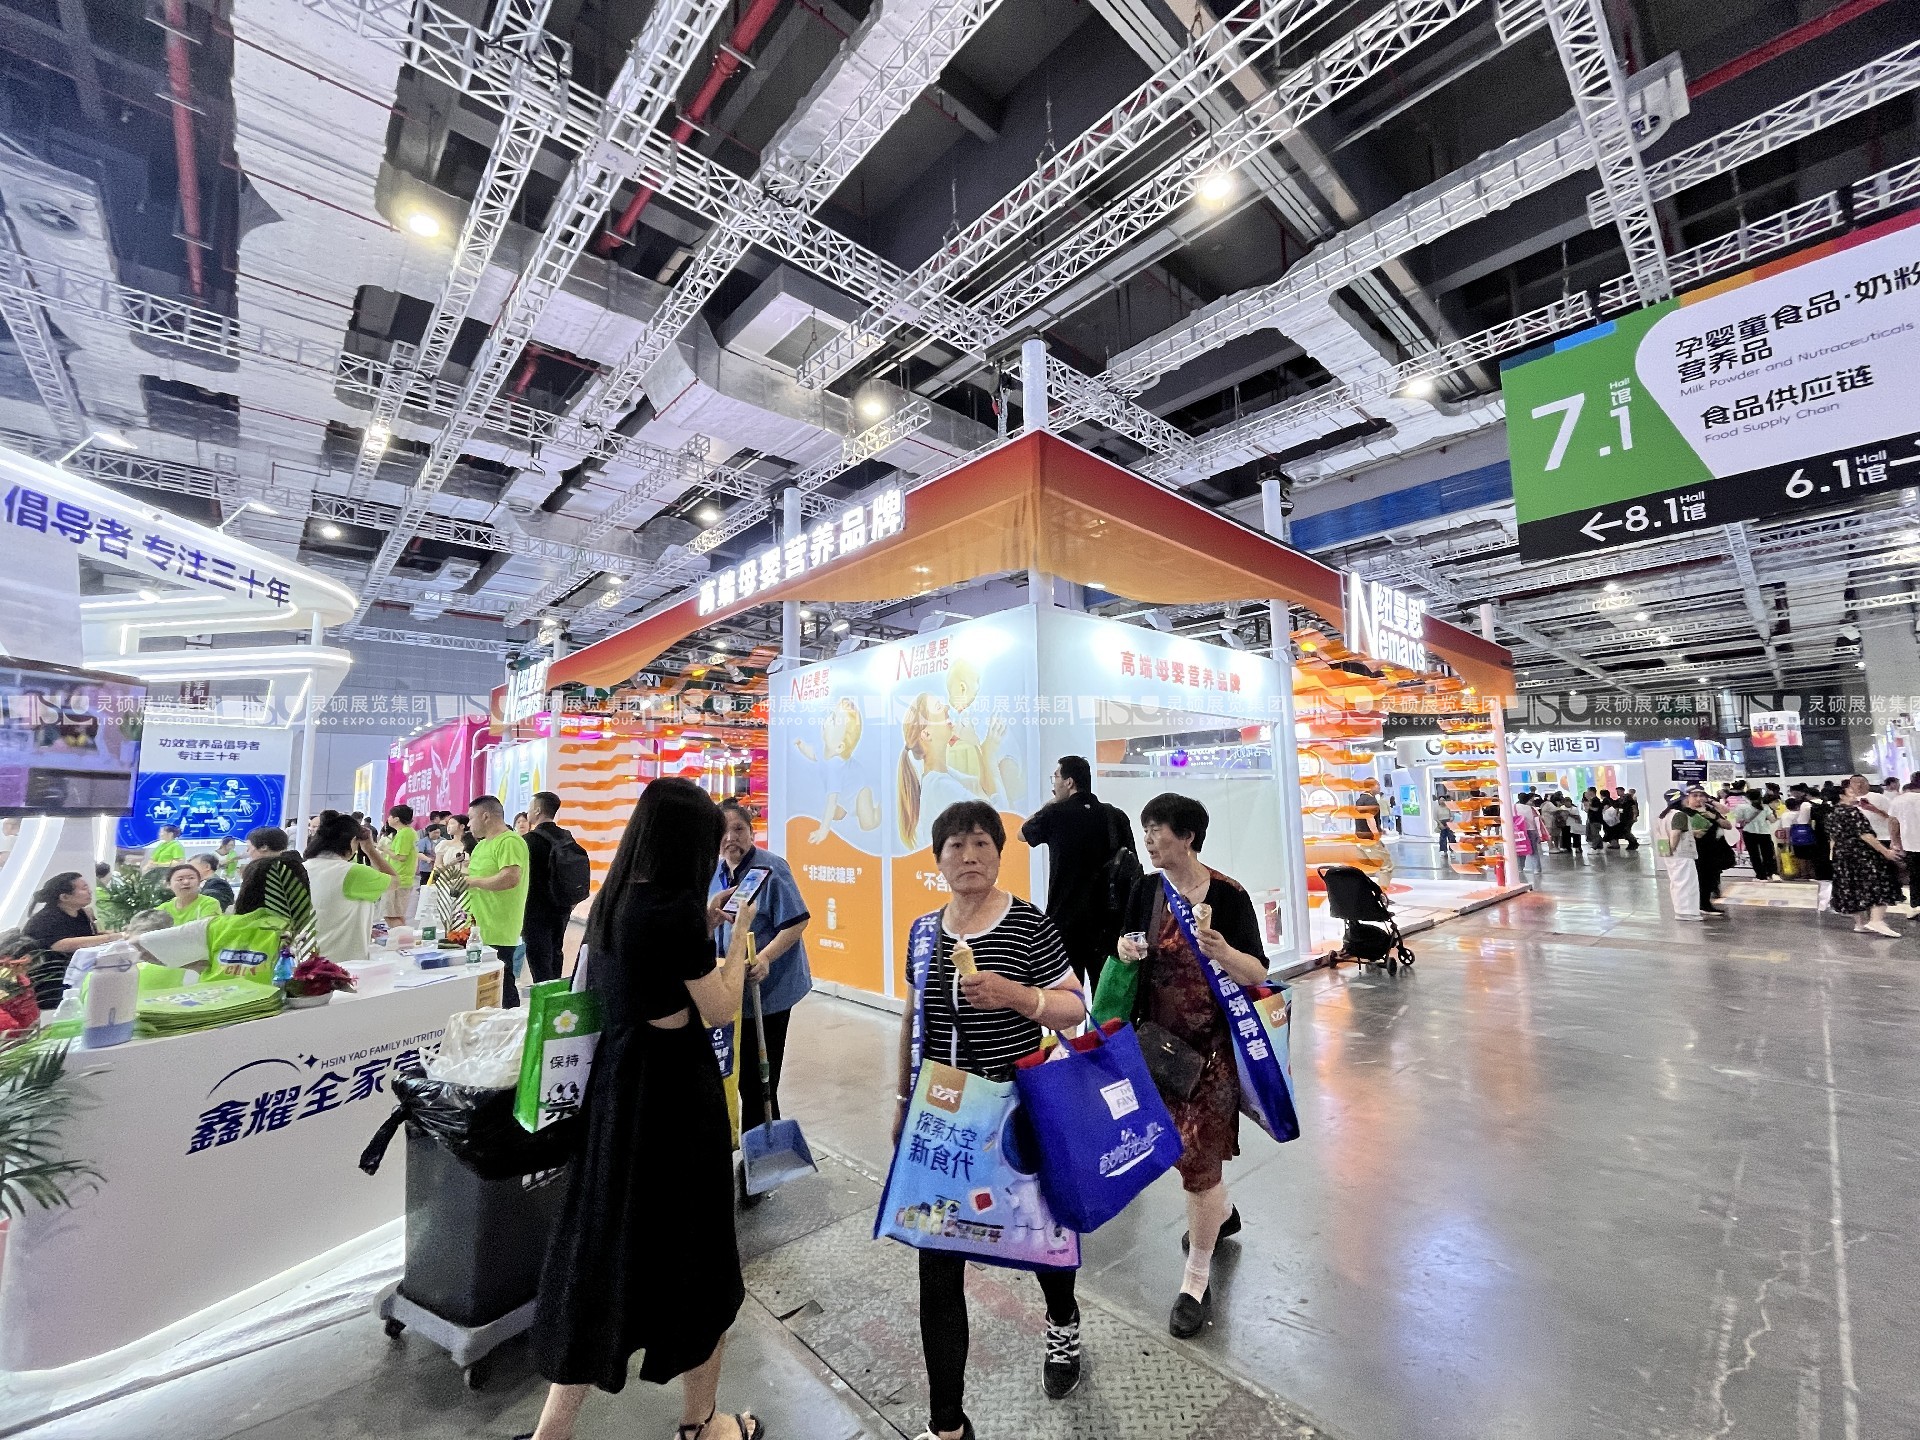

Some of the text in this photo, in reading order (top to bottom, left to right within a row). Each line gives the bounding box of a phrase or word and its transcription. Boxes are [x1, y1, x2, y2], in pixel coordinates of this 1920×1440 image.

[1677, 337, 1773, 384] 营养品
[1679, 322, 1914, 398] Milk Powder and Nutraceuticals
[1609, 377, 1631, 390] Hall
[1611, 388, 1632, 406] 馆
[1700, 363, 1875, 430] 食品供应链
[1704, 401, 1841, 444] Food Supply Chain
[1855, 450, 1888, 464] Hall
[1784, 458, 1852, 499] 6.1
[1857, 463, 1889, 486] 馆
[1680, 490, 1706, 504] Hall
[1682, 501, 1707, 522] 馆
[1625, 496, 1680, 533] 8.1
[5, 485, 291, 609] 倡导者 专注三十年
[698, 489, 902, 616] 高端母婴营养品牌
[896, 646, 950, 682] Nemans
[914, 637, 950, 662] 纽曼思
[804, 668, 830, 687] 纽曼思
[1120, 649, 1242, 694] 高端母婴营养品牌
[159, 738, 261, 751] 功效营养品倡导者
[178, 750, 241, 762] 专注三十年
[1425, 734, 1545, 759] Geniu Key
[1549, 736, 1601, 754] 即适可
[320, 1054, 347, 1070] HSIN
[349, 1050, 368, 1062] YAO
[369, 1040, 402, 1057] FAMILY
[550, 1054, 579, 1069] 保持
[185, 1043, 441, 1156] 鑫耀全家
[916, 1110, 978, 1151] 探索太空
[908, 1133, 975, 1182] 新食代
